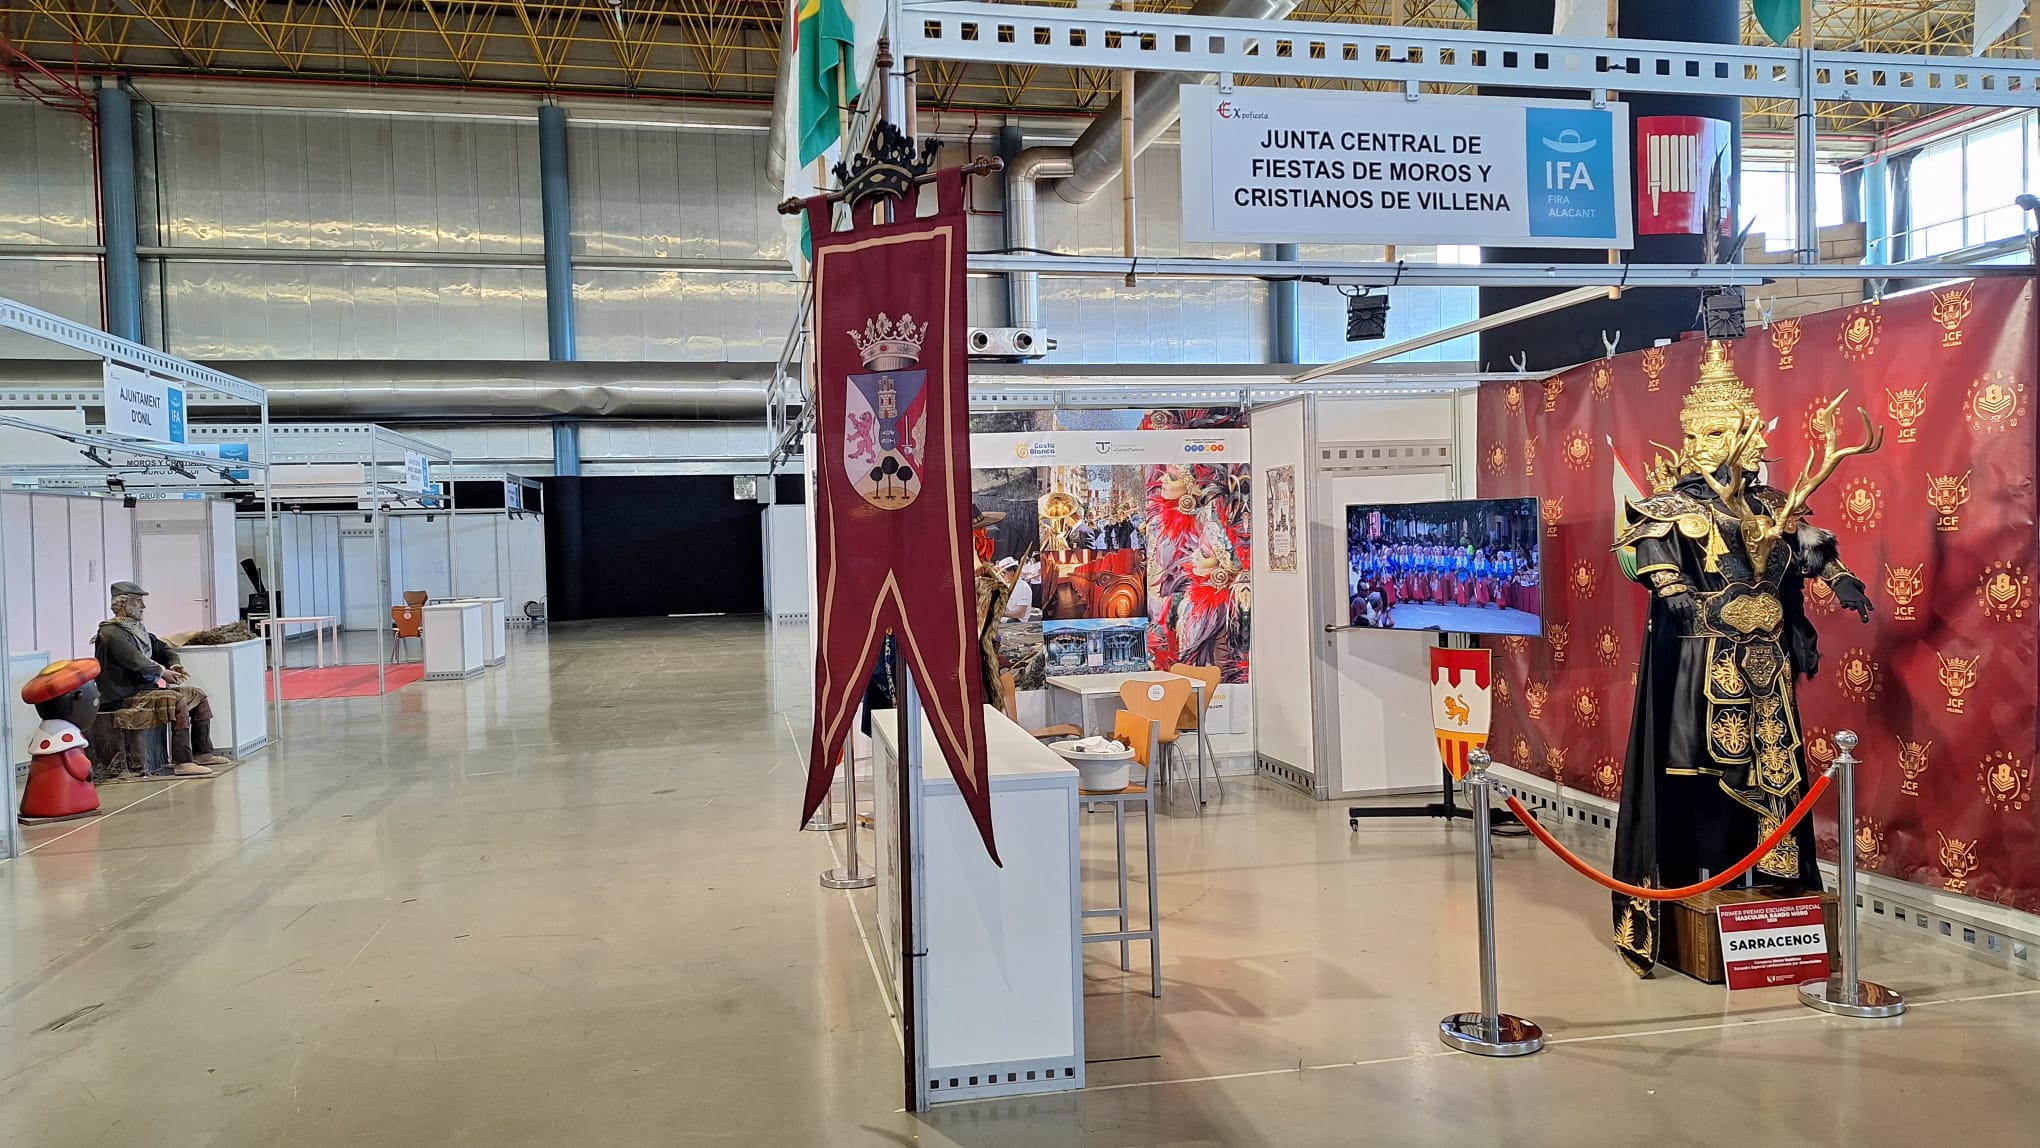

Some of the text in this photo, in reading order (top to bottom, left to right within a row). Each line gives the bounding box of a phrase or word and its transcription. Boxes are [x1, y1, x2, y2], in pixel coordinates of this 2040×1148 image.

[1260, 129, 1482, 155] JUNTA CENTRAL DE
[1252, 158, 1493, 183] FIESTAS DE MOROS Y
[1545, 160, 1596, 191] IFA
[1234, 187, 1511, 212] CRISTIANOS DE VILLENA
[1548, 194, 1571, 205] FIRA
[1548, 208, 1596, 219] ALACANT
[1942, 330, 1962, 342] JCF
[1778, 355, 1794, 366] JCF
[120, 387, 161, 409] AJUNTAMENT
[131, 409, 152, 426] D'ONIL
[171, 409, 181, 424] IFA
[1897, 428, 1917, 438] JCF
[1936, 516, 1959, 526] JCF
[1894, 606, 1915, 615] JCF
[1946, 698, 1965, 708] JCF
[1901, 780, 1919, 790] JCF
[1944, 878, 1967, 888] JCF
[1765, 906, 1795, 914] ESCUADRA
[1735, 914, 1768, 922] MASCULINA
[1729, 933, 1820, 951] SARRACENOS
